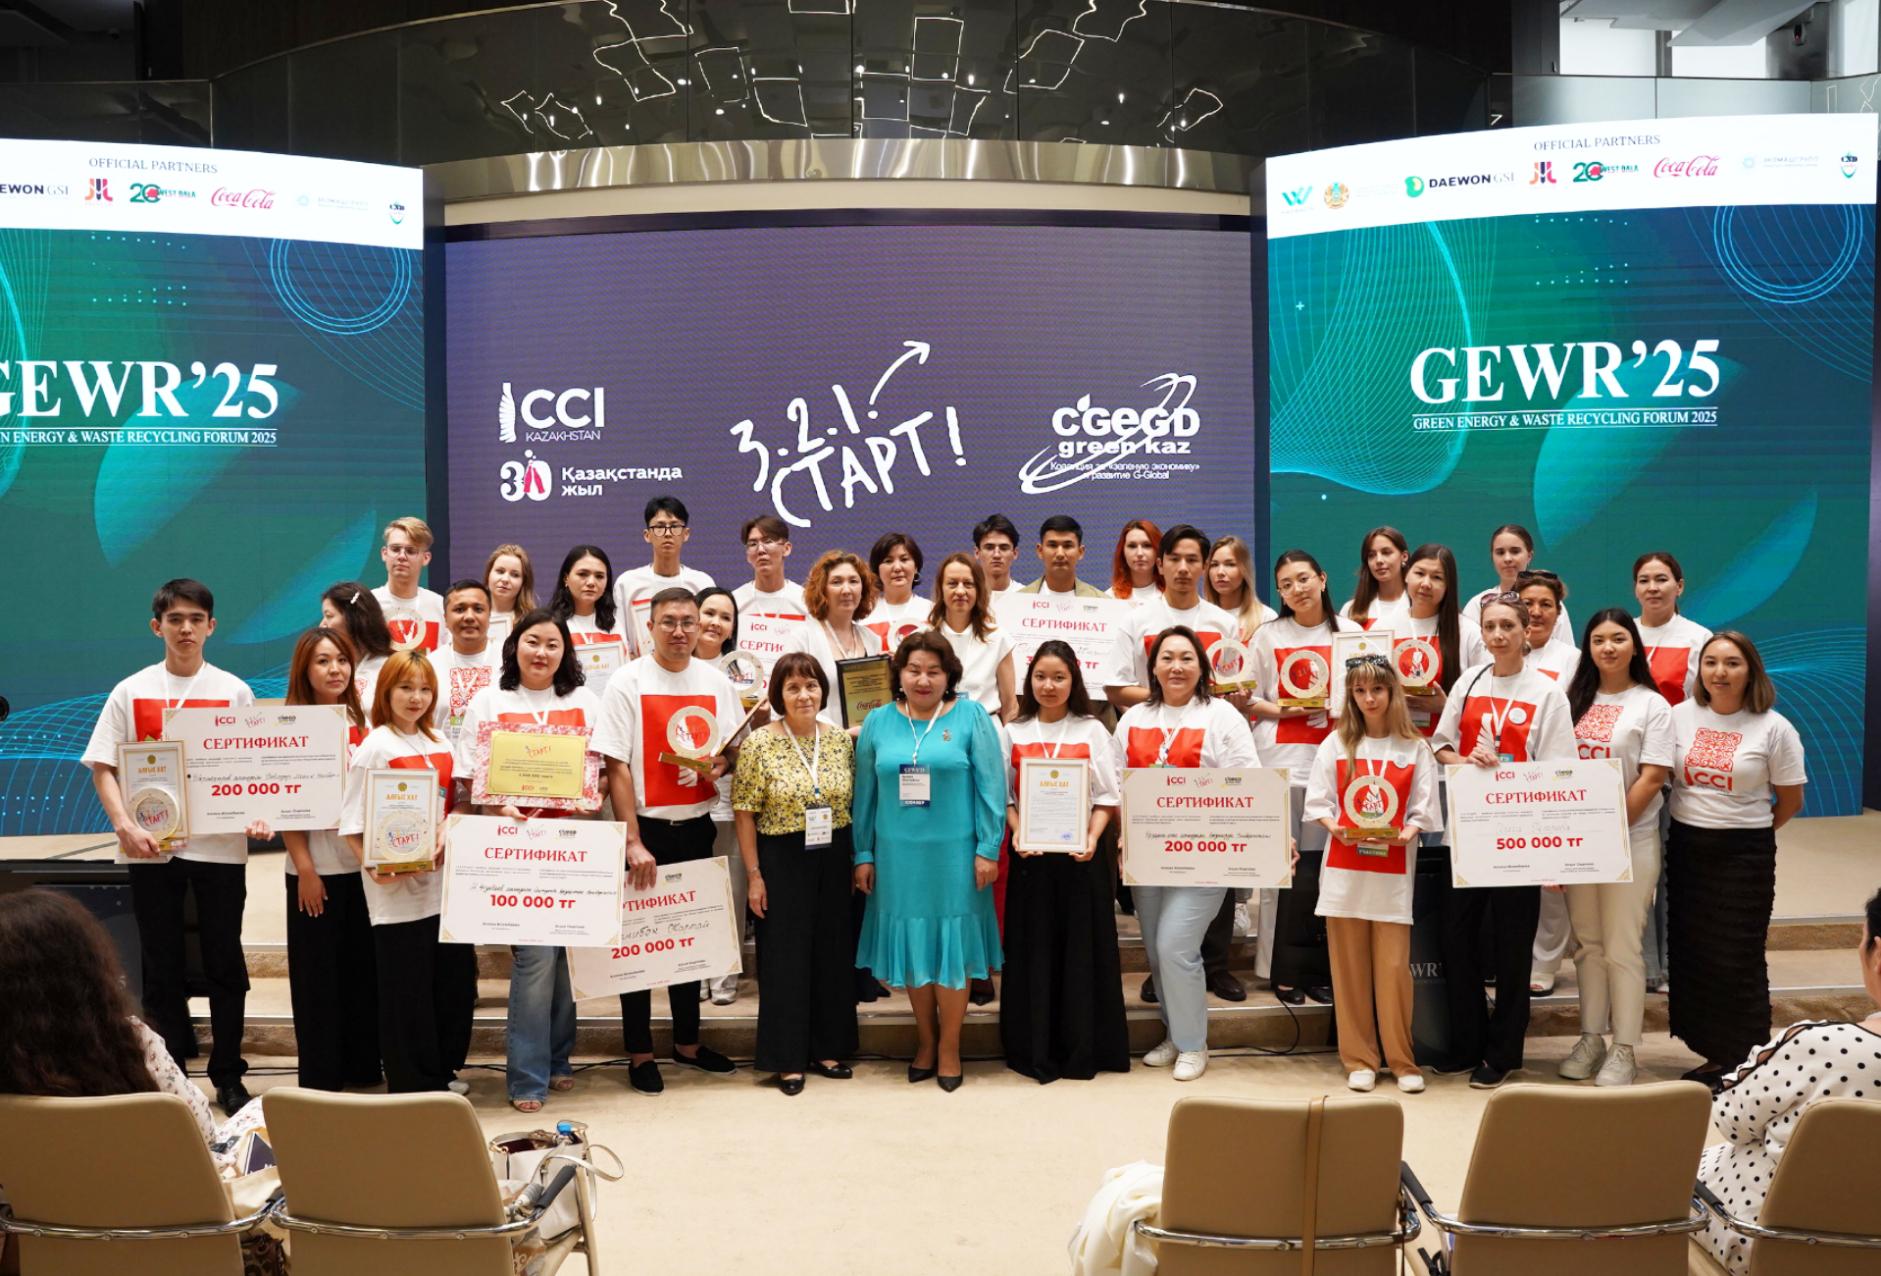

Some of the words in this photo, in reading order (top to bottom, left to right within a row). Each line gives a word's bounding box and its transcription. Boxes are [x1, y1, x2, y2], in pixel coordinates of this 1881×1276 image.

[1534, 139, 1591, 151] OFFICIAL
[1595, 134, 1661, 148] PARTNERS
[89, 157, 148, 170] OFFICIAL
[151, 160, 218, 174] PARTNERS
[1429, 174, 1492, 188] DAEWON
[0, 183, 45, 195] EWON
[1410, 339, 1720, 404] GEWR’25
[1413, 417, 1454, 430] GREEN
[1457, 415, 1507, 428] ENERGY
[1509, 414, 1520, 427] &
[1522, 413, 1565, 427] WASTE
[1567, 412, 1641, 426] RECYCLING
[1643, 411, 1689, 425] FORUM
[1691, 410, 1718, 424] 2025
[13, 431, 65, 444] ENERGY
[67, 431, 78, 443] &
[81, 431, 125, 444] WASTE
[127, 431, 201, 444] RECYCLING
[203, 431, 249, 444] FORUM
[251, 431, 277, 444] 2025
[525, 430, 601, 442] KAZAKHSTAN
[1145, 439, 1192, 454] kaz
[561, 466, 683, 483] Қазақстанда
[561, 484, 603, 496] жыл
[1022, 617, 1108, 633] СЕРТИФИКАТ
[740, 640, 783, 652] СЕРТИ
[203, 735, 309, 750] СЕРТИФИКАТ
[211, 783, 243, 797] 200
[247, 783, 280, 796] 000
[285, 783, 302, 794] тг
[1485, 789, 1588, 805] СЕРТИФИКАТ
[1156, 796, 1254, 809] СЕРТИФИКАТ
[1164, 841, 1193, 852] 200
[1197, 841, 1227, 852] 000
[1231, 842, 1248, 852] тг
[1496, 837, 1527, 850] 500
[1531, 836, 1562, 849] 000
[1566, 837, 1583, 847] тг
[484, 846, 588, 863] СЕРТИФИКАТ
[490, 894, 518, 908] 100
[523, 896, 554, 909] 000
[558, 898, 576, 909] тг
[623, 890, 697, 912] ТИФИКАТ
[611, 944, 641, 960] 200
[645, 938, 675, 953] 000
[679, 936, 696, 947] тг
